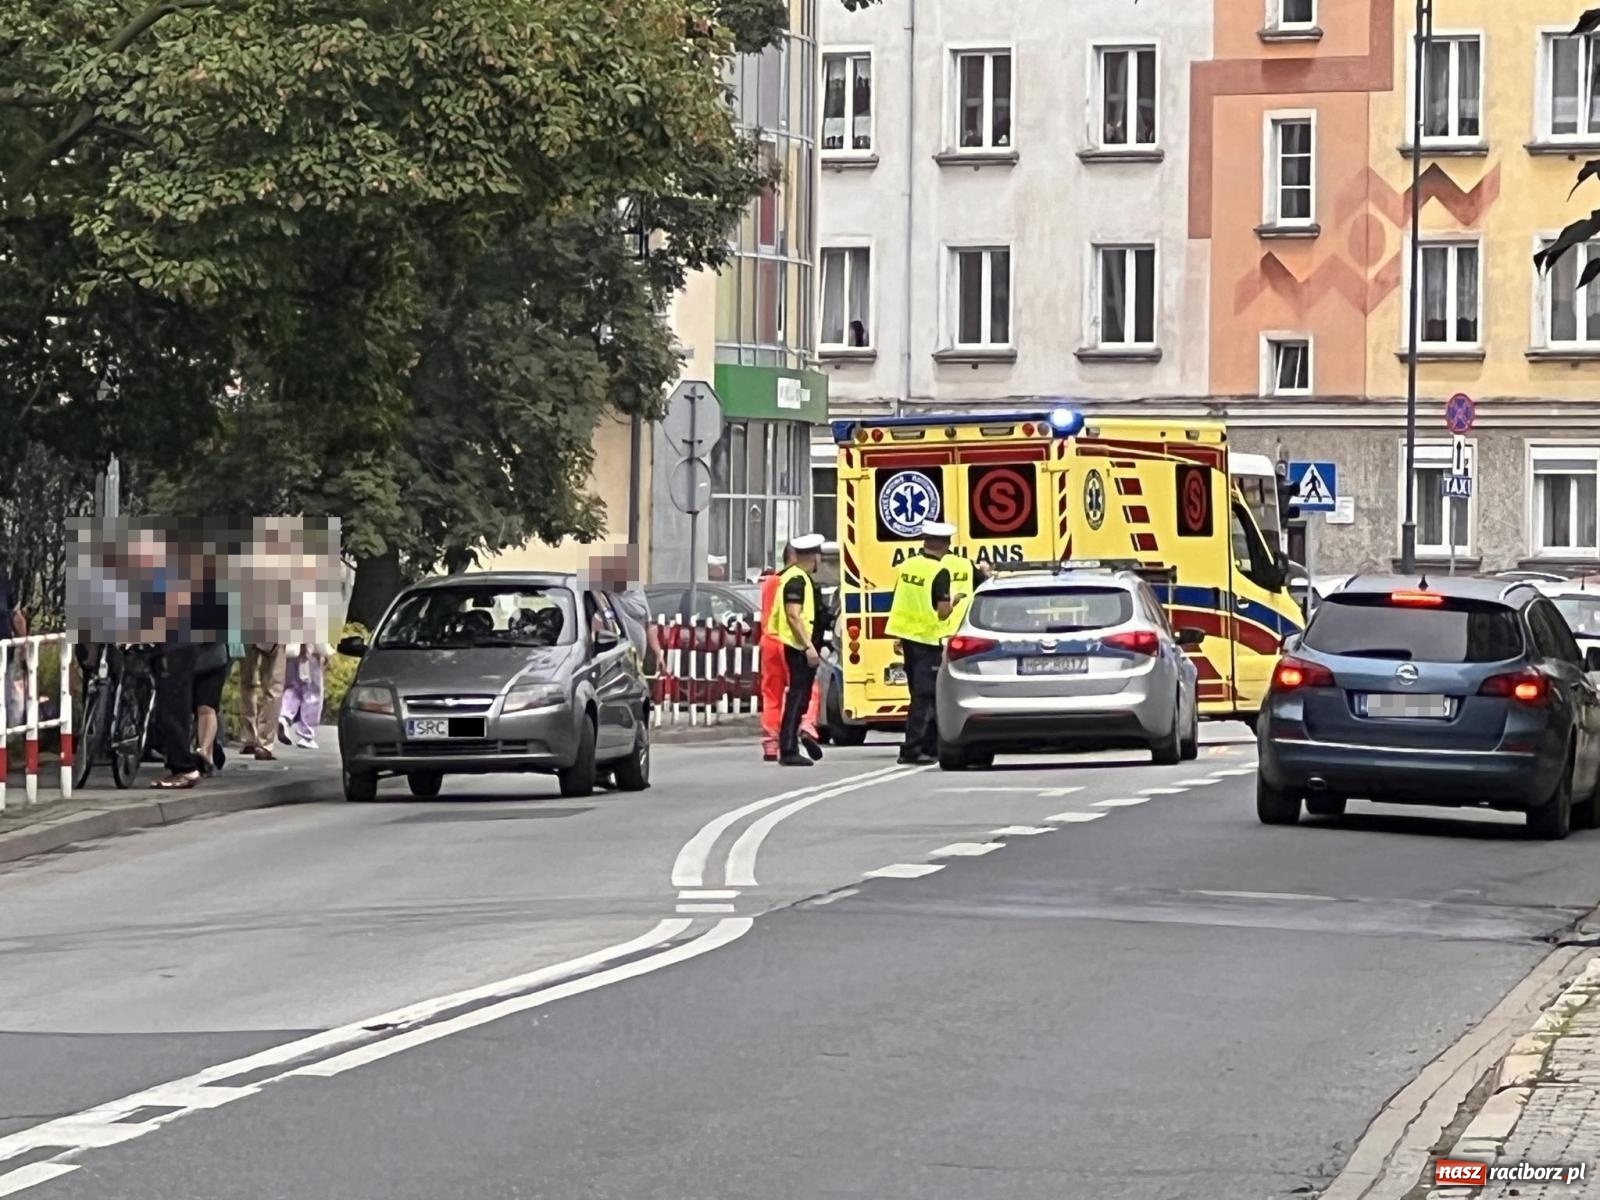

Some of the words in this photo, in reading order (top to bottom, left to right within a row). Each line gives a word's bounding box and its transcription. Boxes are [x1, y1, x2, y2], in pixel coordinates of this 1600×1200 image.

[1443, 477, 1471, 495] TAXI
[986, 481, 1017, 521] S
[416, 721, 446, 735] SRC
